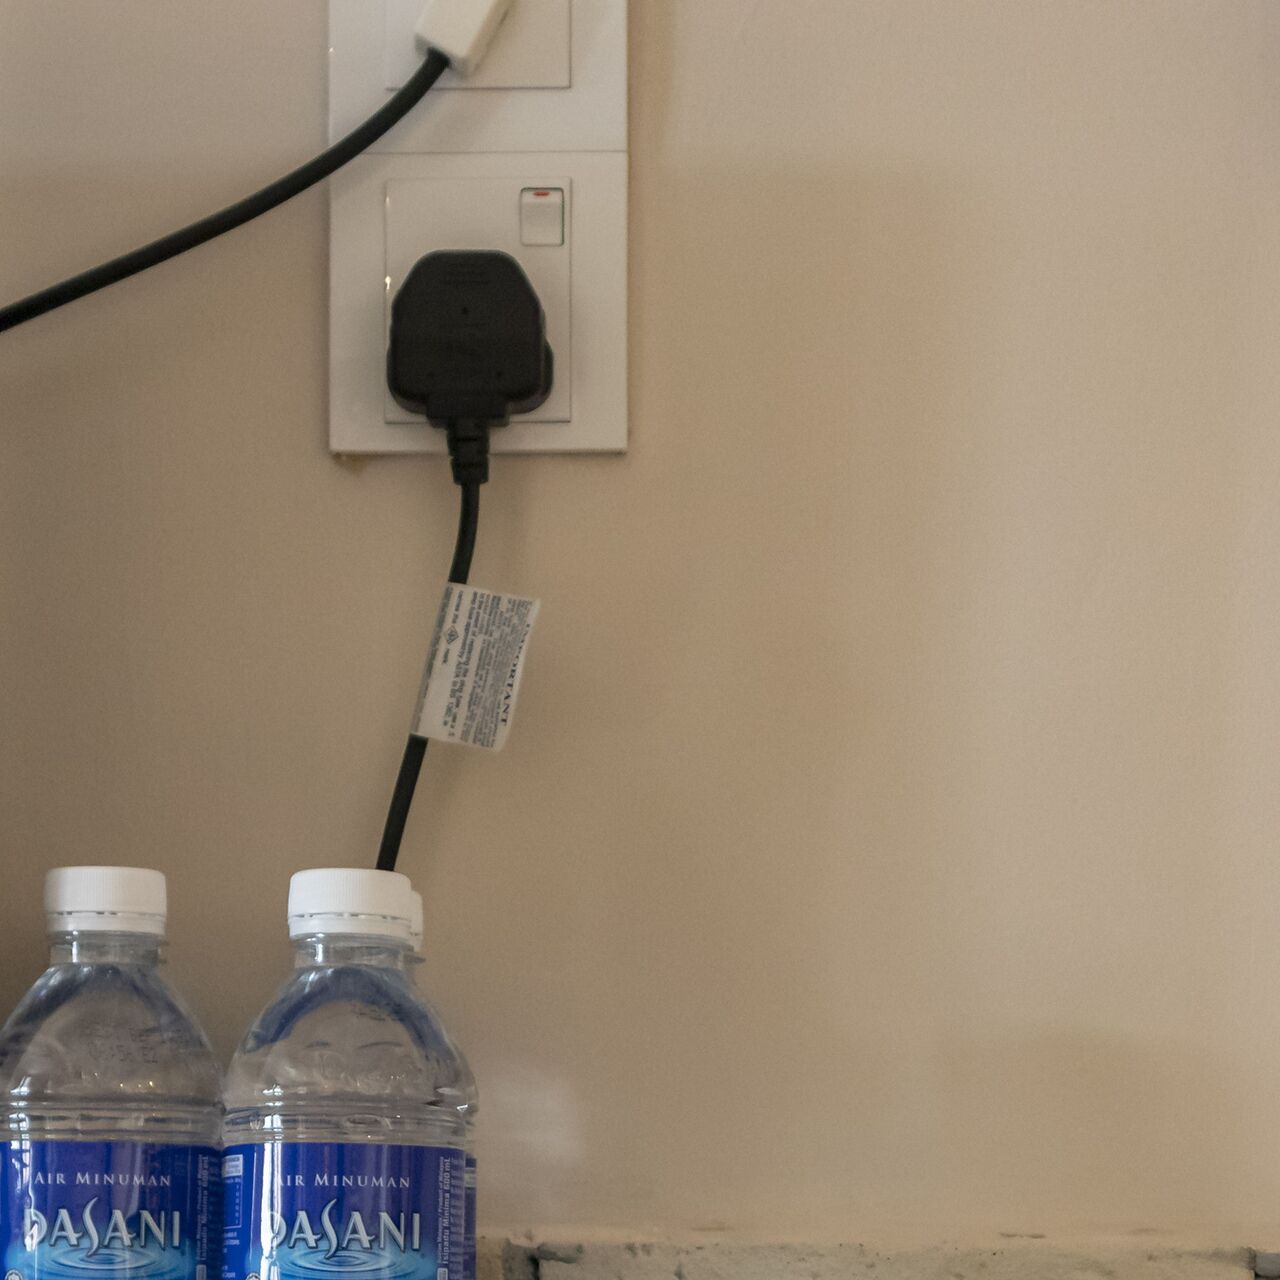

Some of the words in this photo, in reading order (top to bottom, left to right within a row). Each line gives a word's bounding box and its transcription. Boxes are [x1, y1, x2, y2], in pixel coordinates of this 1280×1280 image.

[34, 1171, 66, 1185] AIR
[75, 1171, 171, 1187] MINUMAN
[314, 1172, 411, 1188] MINUMAN
[24, 1196, 181, 1258] DASANI
